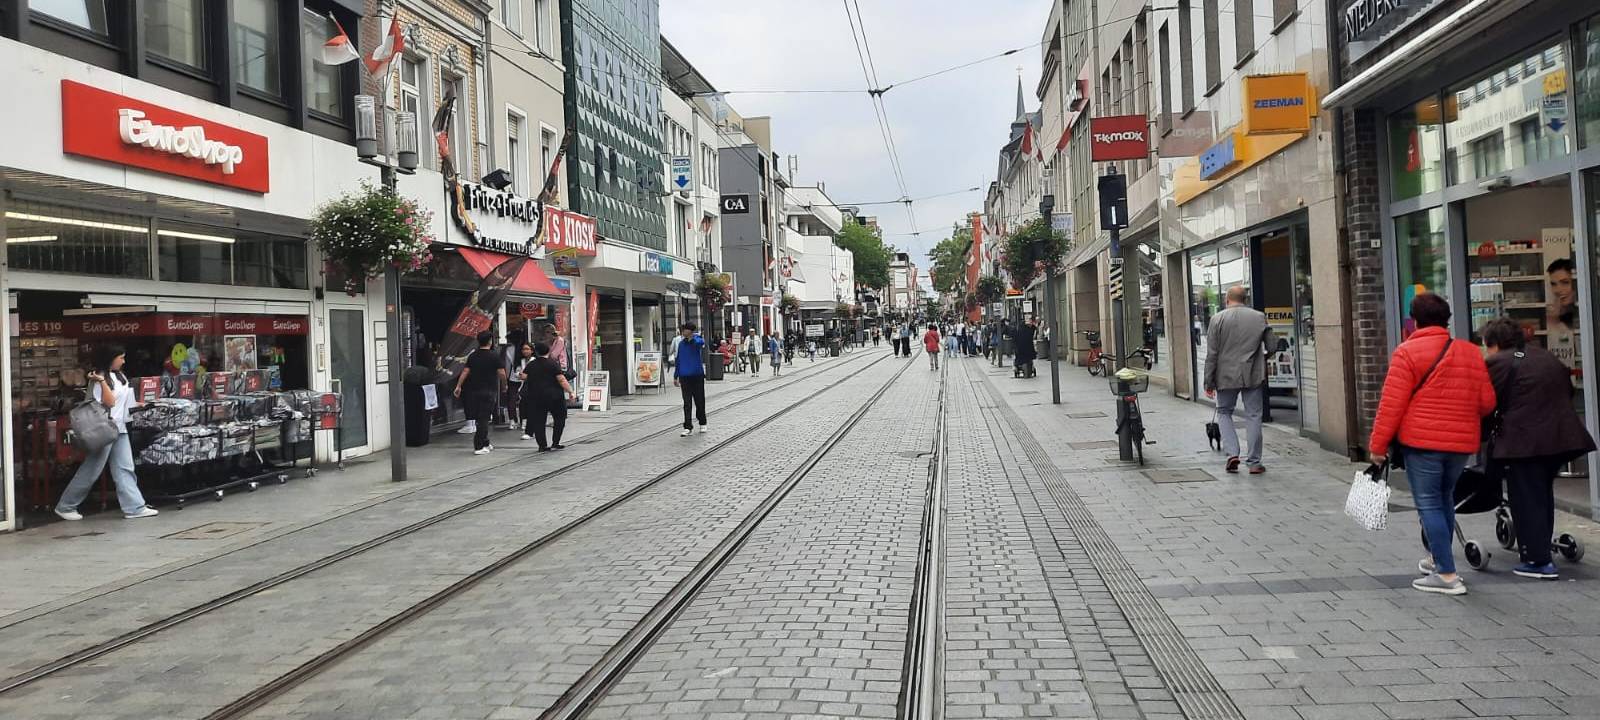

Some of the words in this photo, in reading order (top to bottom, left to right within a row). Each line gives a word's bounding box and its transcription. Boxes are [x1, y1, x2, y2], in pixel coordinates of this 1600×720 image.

[1254, 97, 1304, 108] ZEEMAN
[119, 109, 243, 174] EuroShop
[563, 215, 595, 251] KIOSK
[82, 321, 140, 333] EuroShop
[167, 320, 204, 331] EuroShop
[225, 320, 256, 331] EuroShop
[273, 321, 301, 331] EuroShop
